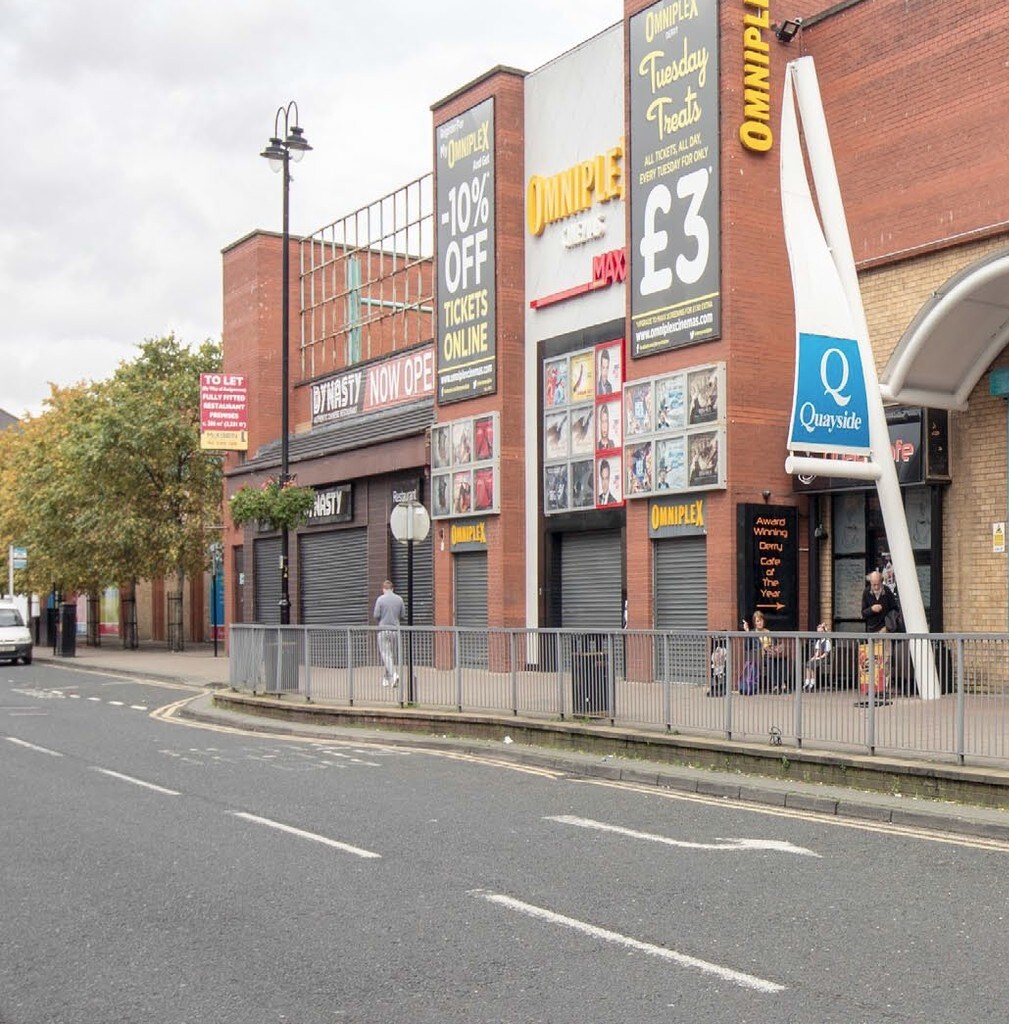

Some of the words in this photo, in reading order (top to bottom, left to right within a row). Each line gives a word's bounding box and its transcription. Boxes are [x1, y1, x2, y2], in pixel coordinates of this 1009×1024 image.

[639, 37, 709, 94] Tuesday
[647, 86, 702, 141] Treats
[448, 120, 489, 168] OMNIPLEX
[644, 154, 654, 167] ALL
[678, 138, 689, 152] ALL
[640, 168, 657, 185] EVERY
[657, 158, 681, 177] TUESDAY
[681, 153, 693, 167] FOR
[694, 145, 709, 162] ONLY
[528, 136, 625, 236] OMNIPLE
[445, 228, 488, 294] OFF
[444, 289, 488, 329] TICKETS
[444, 322, 488, 362] ONLINE
[204, 375, 221, 385] TO
[223, 376, 243, 386] LET
[370, 362, 401, 406] NOW
[820, 348, 851, 406] Q
[203, 393, 222, 401] FULLY
[223, 394, 246, 402] FITTED
[203, 402, 245, 410] RESTAURANT
[313, 372, 362, 414] DYNASTY
[800, 402, 861, 433] Quayside
[308, 490, 342, 518] NASTY
[393, 489, 417, 503] Restaurant
[651, 499, 704, 530] OMNIPLEX
[756, 517, 785, 526] Award
[451, 522, 486, 545] OMNIPLEX
[753, 528, 788, 538] Winning
[759, 542, 783, 551] Derry
[766, 568, 775, 576] of
[760, 589, 781, 598] Year
